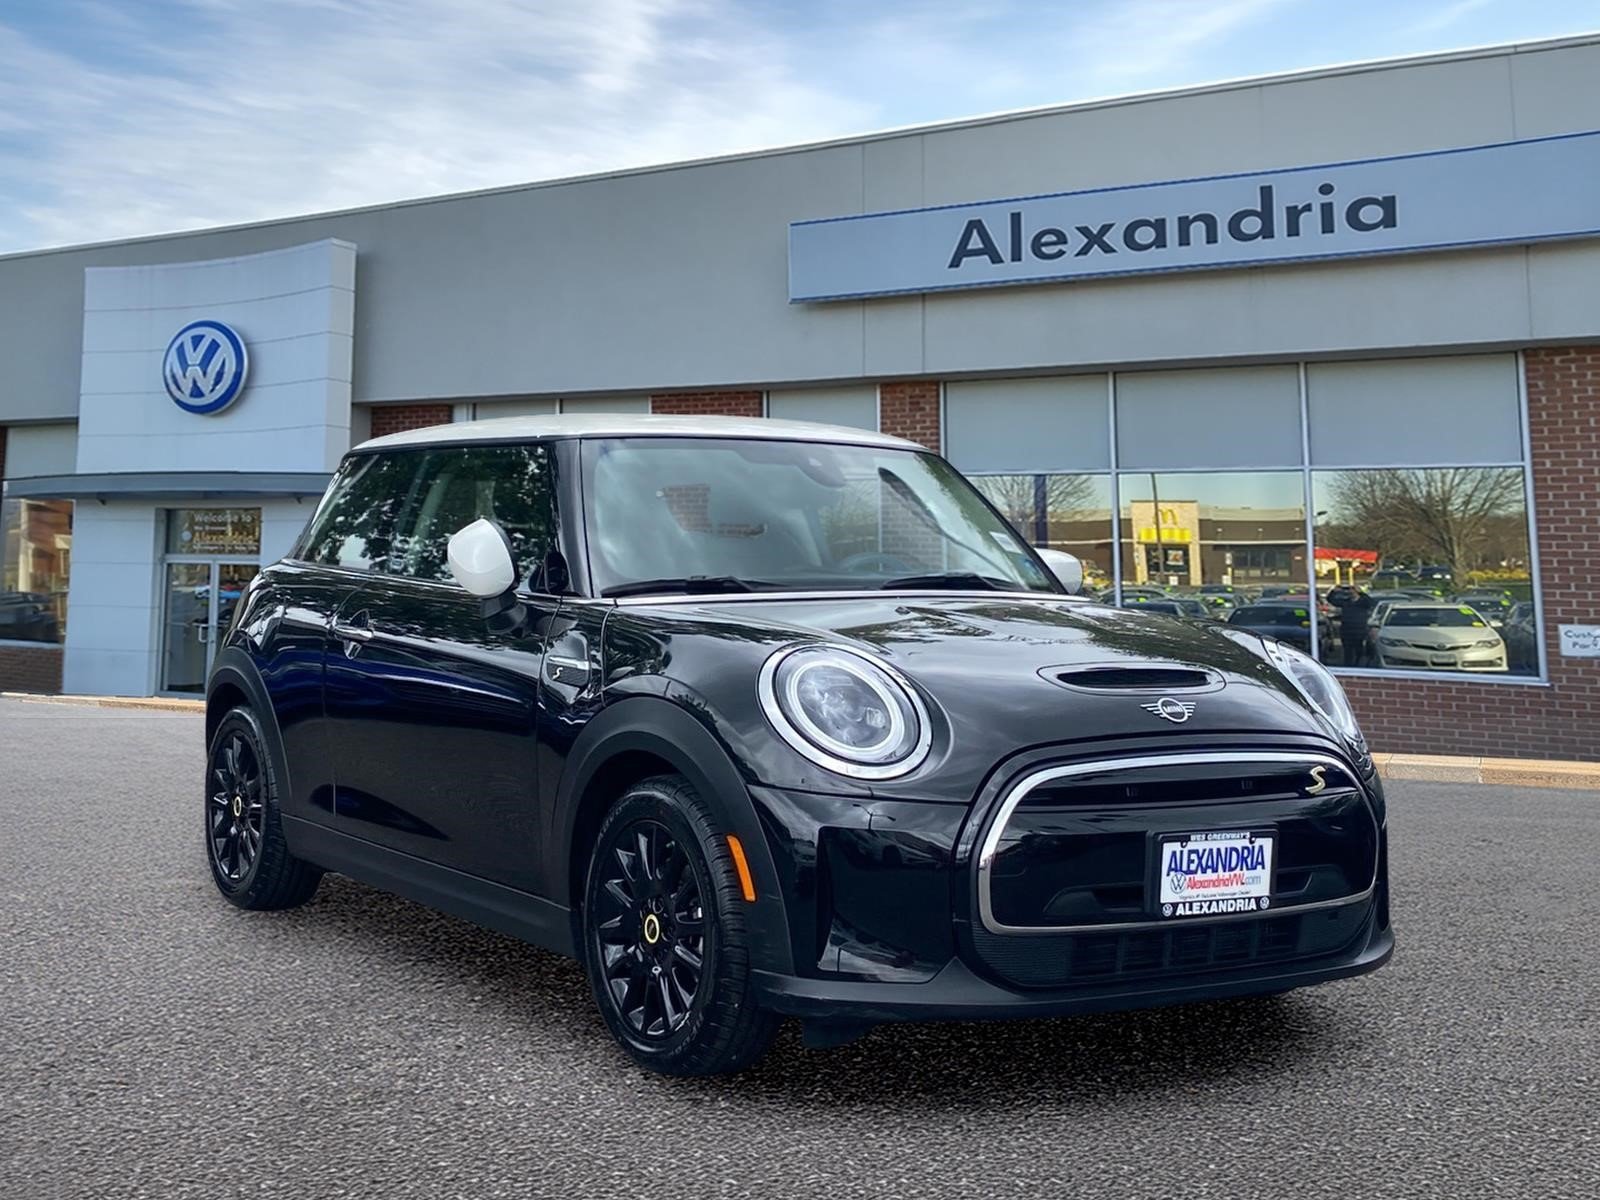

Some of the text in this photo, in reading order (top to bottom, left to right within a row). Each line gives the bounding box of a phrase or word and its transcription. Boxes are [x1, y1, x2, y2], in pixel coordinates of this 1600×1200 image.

[948, 183, 1398, 268] Alexandria
[193, 532, 254, 545] Alexadria
[1305, 765, 1326, 794] S
[1190, 833, 1206, 841] WES
[1166, 845, 1265, 877] ALEXANDRIA
[1176, 898, 1257, 916] ALEXANDRIA
